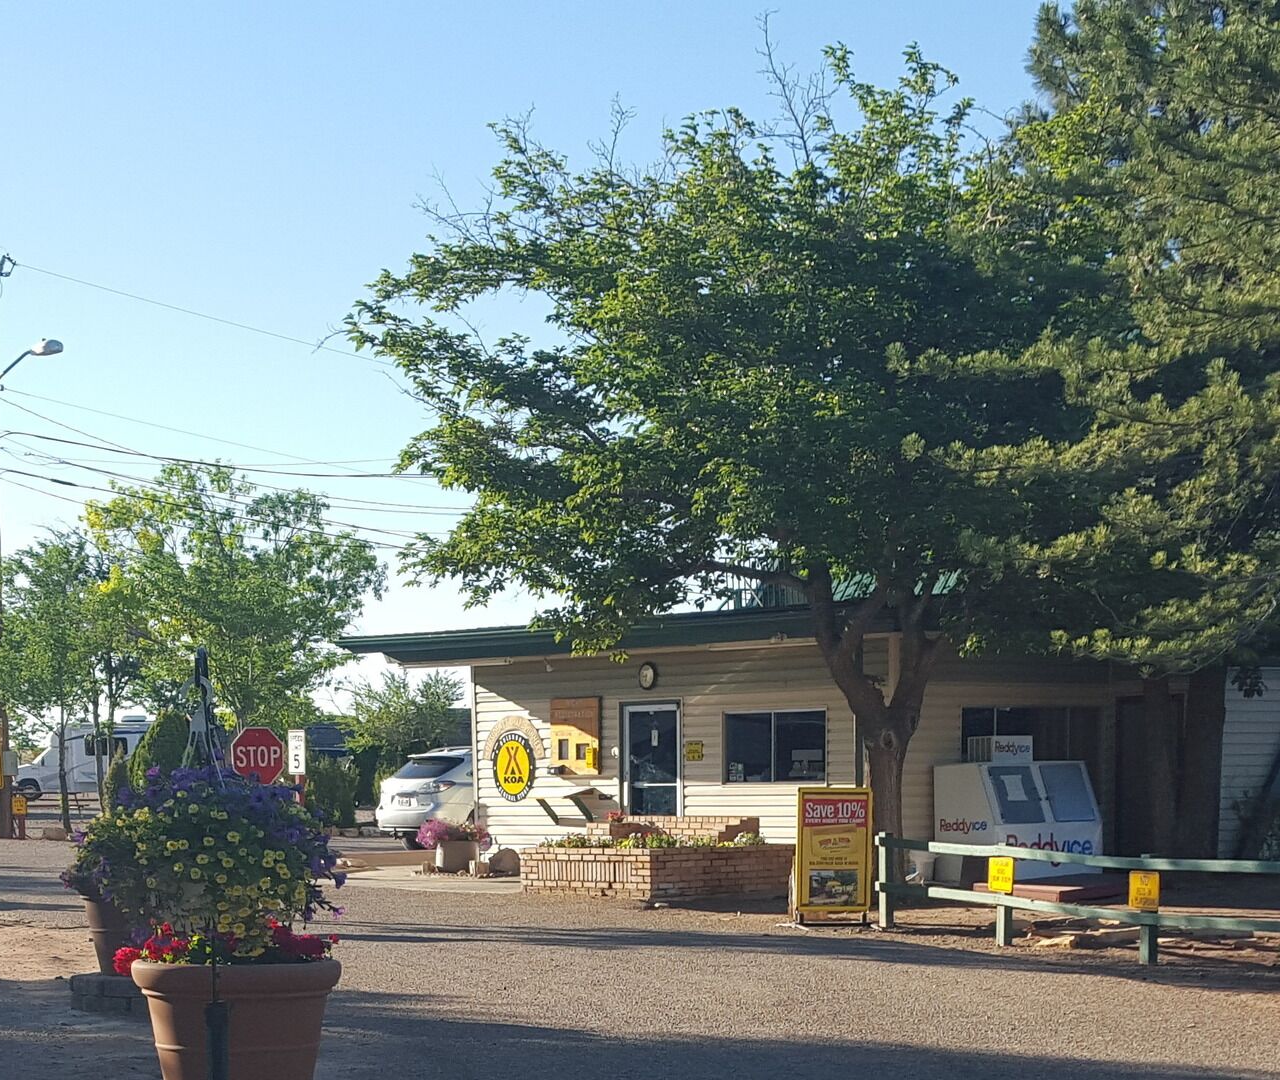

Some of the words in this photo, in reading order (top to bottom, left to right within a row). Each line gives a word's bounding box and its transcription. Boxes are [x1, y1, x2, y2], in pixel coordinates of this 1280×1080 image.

[236, 745, 281, 768] STOP
[294, 754, 300, 769] 5
[503, 776, 525, 784] KOA
[806, 802, 834, 818] Save
